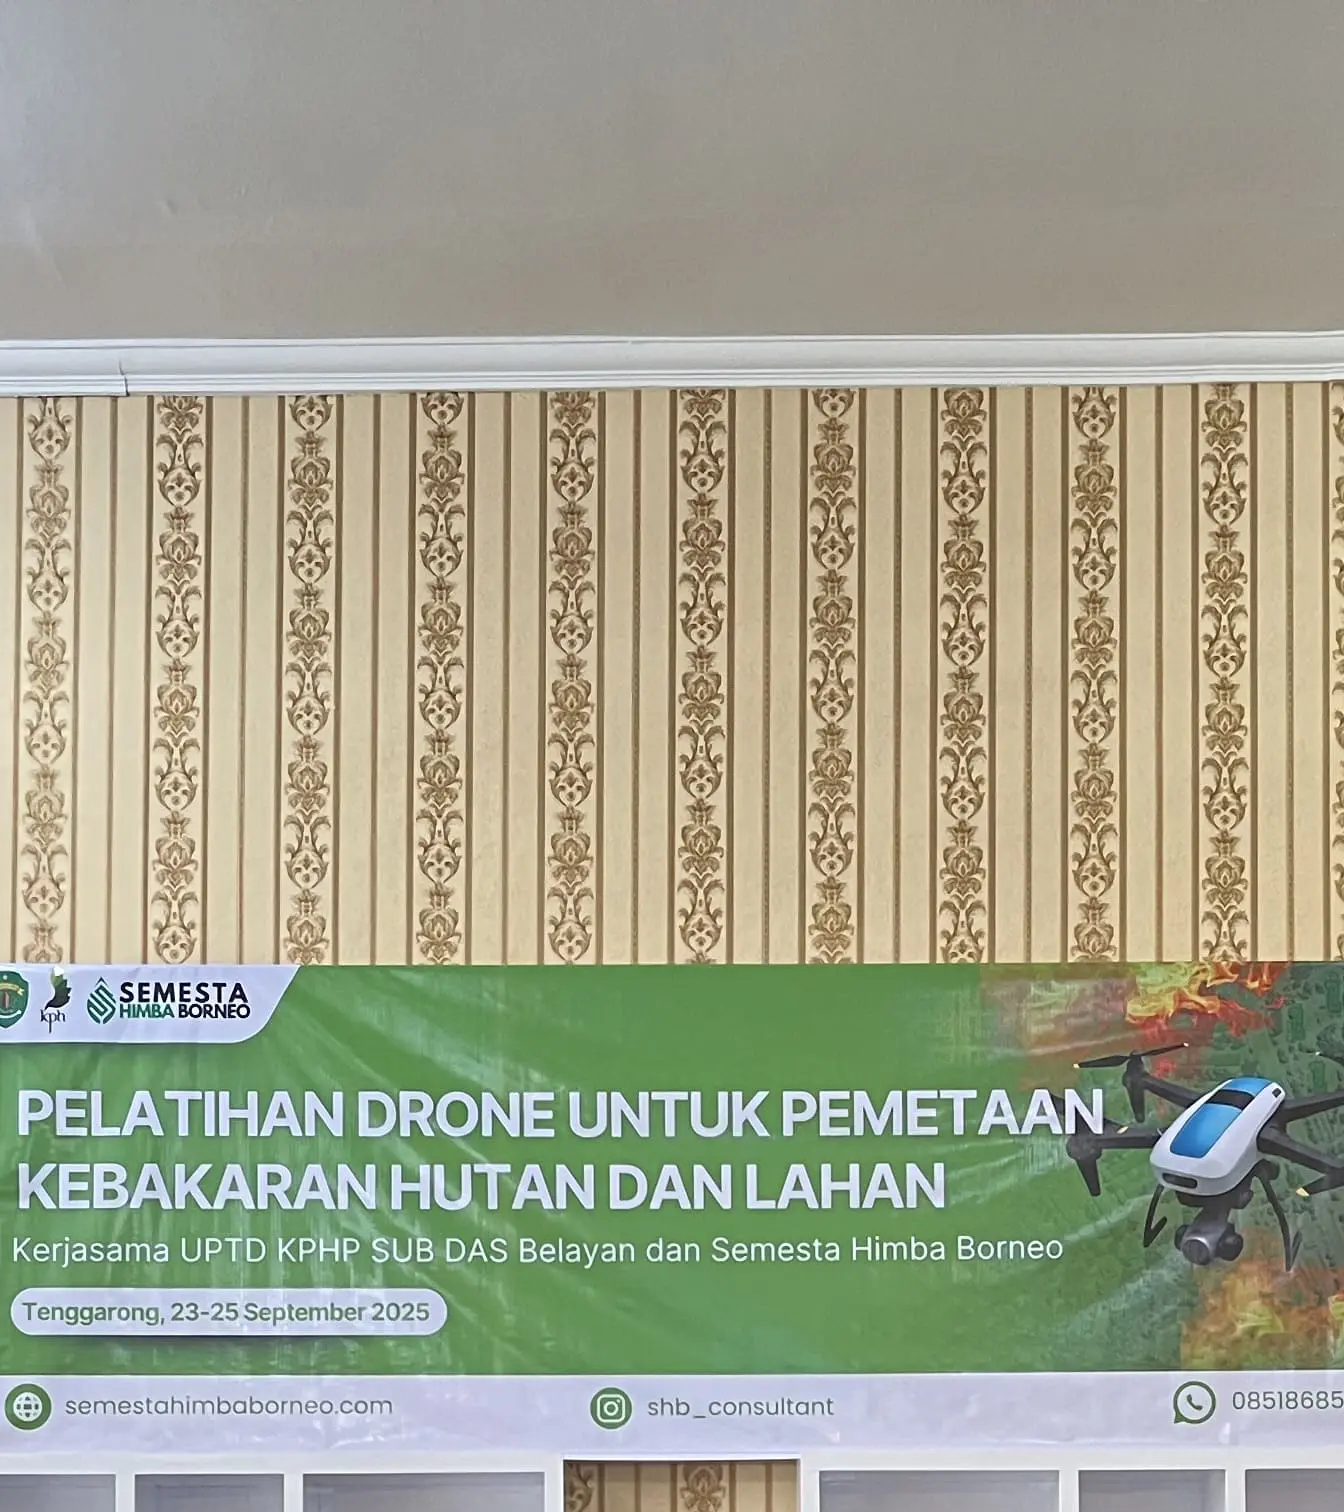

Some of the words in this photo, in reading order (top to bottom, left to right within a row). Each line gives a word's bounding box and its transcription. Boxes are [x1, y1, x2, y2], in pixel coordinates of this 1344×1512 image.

[119, 981, 249, 1003] SEMESTA
[40, 1008, 66, 1034] kph
[119, 1003, 175, 1019] HIMBA
[178, 1003, 251, 1019] BORNEO
[18, 1090, 344, 1138] PELATIHAN
[358, 1090, 555, 1138] DRONE
[568, 1090, 771, 1138] UNTUK
[782, 1089, 1104, 1137] PEMETAAN
[18, 1163, 377, 1211] KEBAKARAN
[391, 1163, 595, 1211] HUTAN
[609, 1164, 732, 1210] DAN
[746, 1162, 945, 1209] LAHAN
[12, 1237, 169, 1268] Kerjasama
[181, 1237, 266, 1264] UPTD
[278, 1237, 360, 1263] KPHP
[371, 1237, 434, 1264] SUB
[445, 1237, 508, 1264] DAS
[519, 1237, 635, 1269] Belayan
[646, 1237, 700, 1262] dan
[711, 1236, 841, 1262] Semesta
[852, 1236, 946, 1261] Himba
[957, 1235, 1064, 1260] Borneo
[21, 1302, 165, 1326] Tenggarong,
[170, 1302, 239, 1322] 23-25
[243, 1301, 367, 1327] September
[371, 1302, 430, 1322] 2025
[64, 1395, 394, 1415] semestahimbaborneo.com
[647, 1397, 835, 1419] shb_consultant
